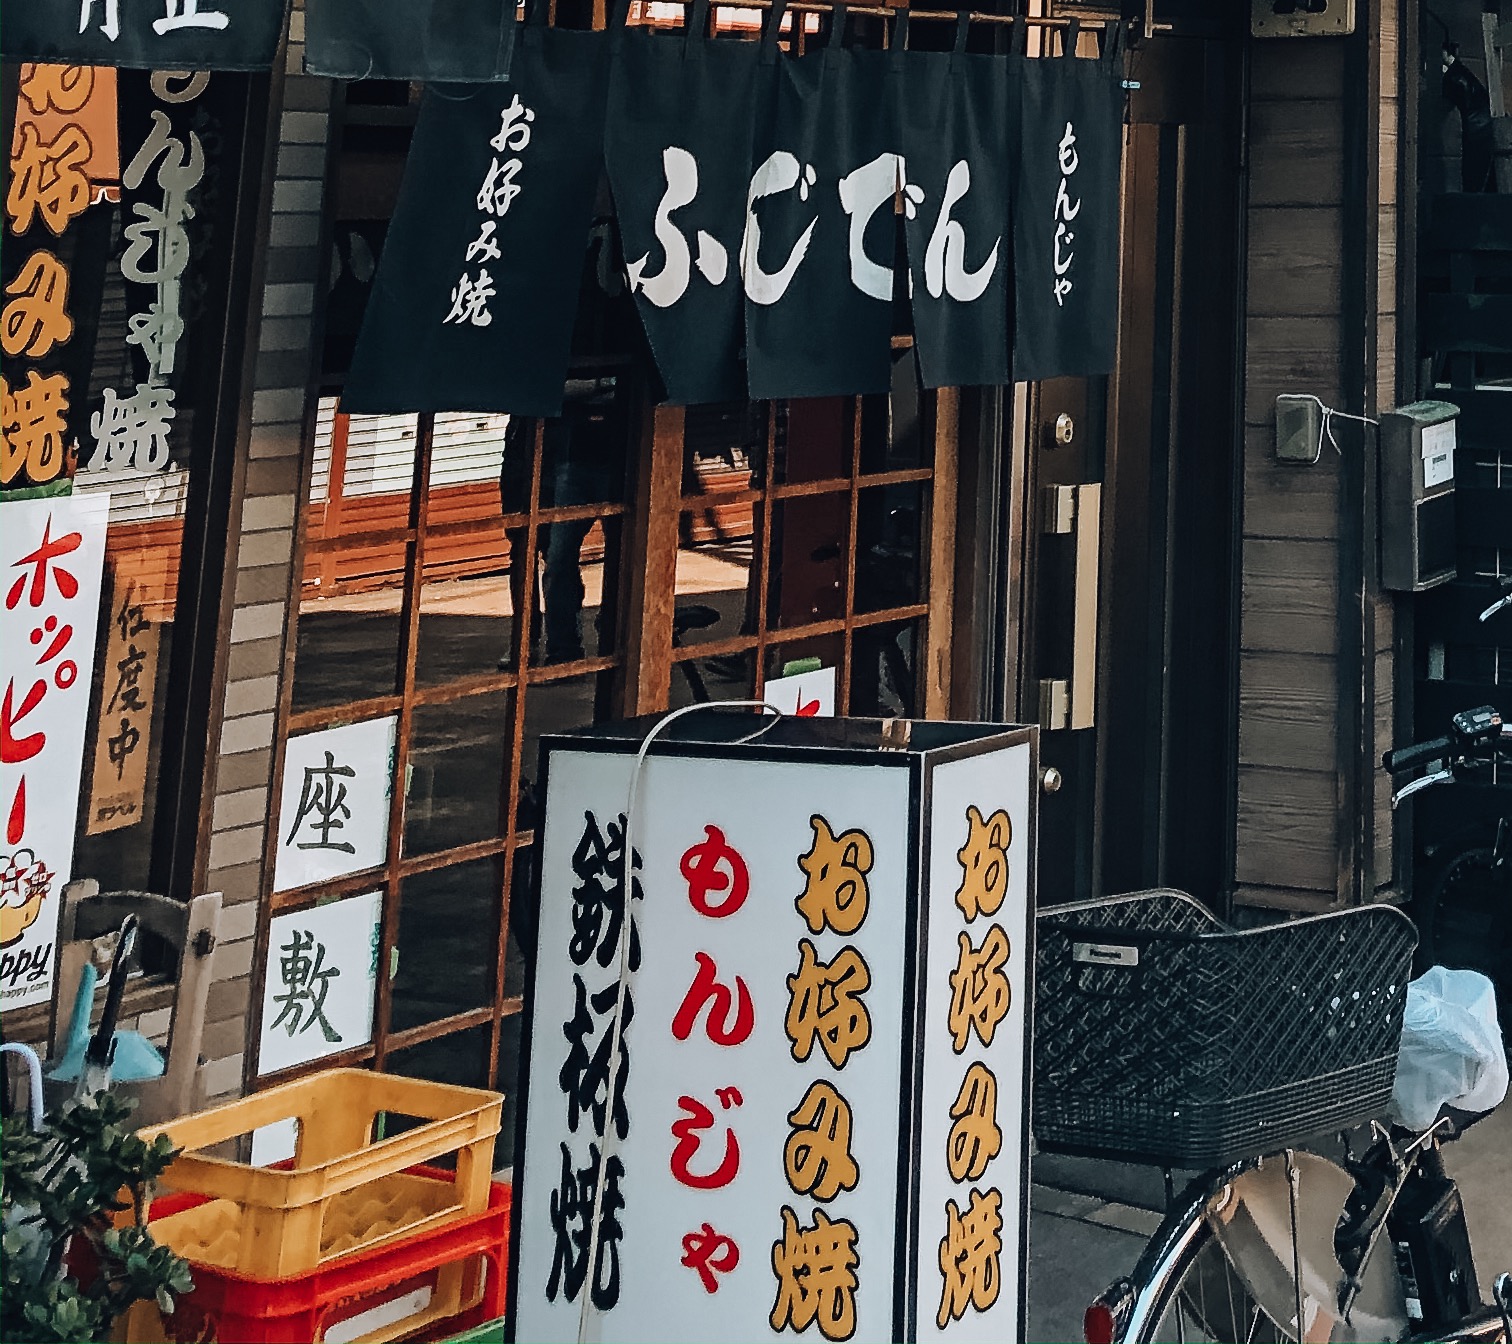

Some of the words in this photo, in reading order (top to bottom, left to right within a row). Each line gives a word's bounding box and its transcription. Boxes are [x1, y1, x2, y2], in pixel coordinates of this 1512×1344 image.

[443, 93, 537, 327] お好み焼
[623, 145, 1001, 309] ふじでん
[0, 513, 82, 846] ホッピー
[769, 813, 874, 1343] お好み焼
[937, 805, 1012, 1329] お好み焼
